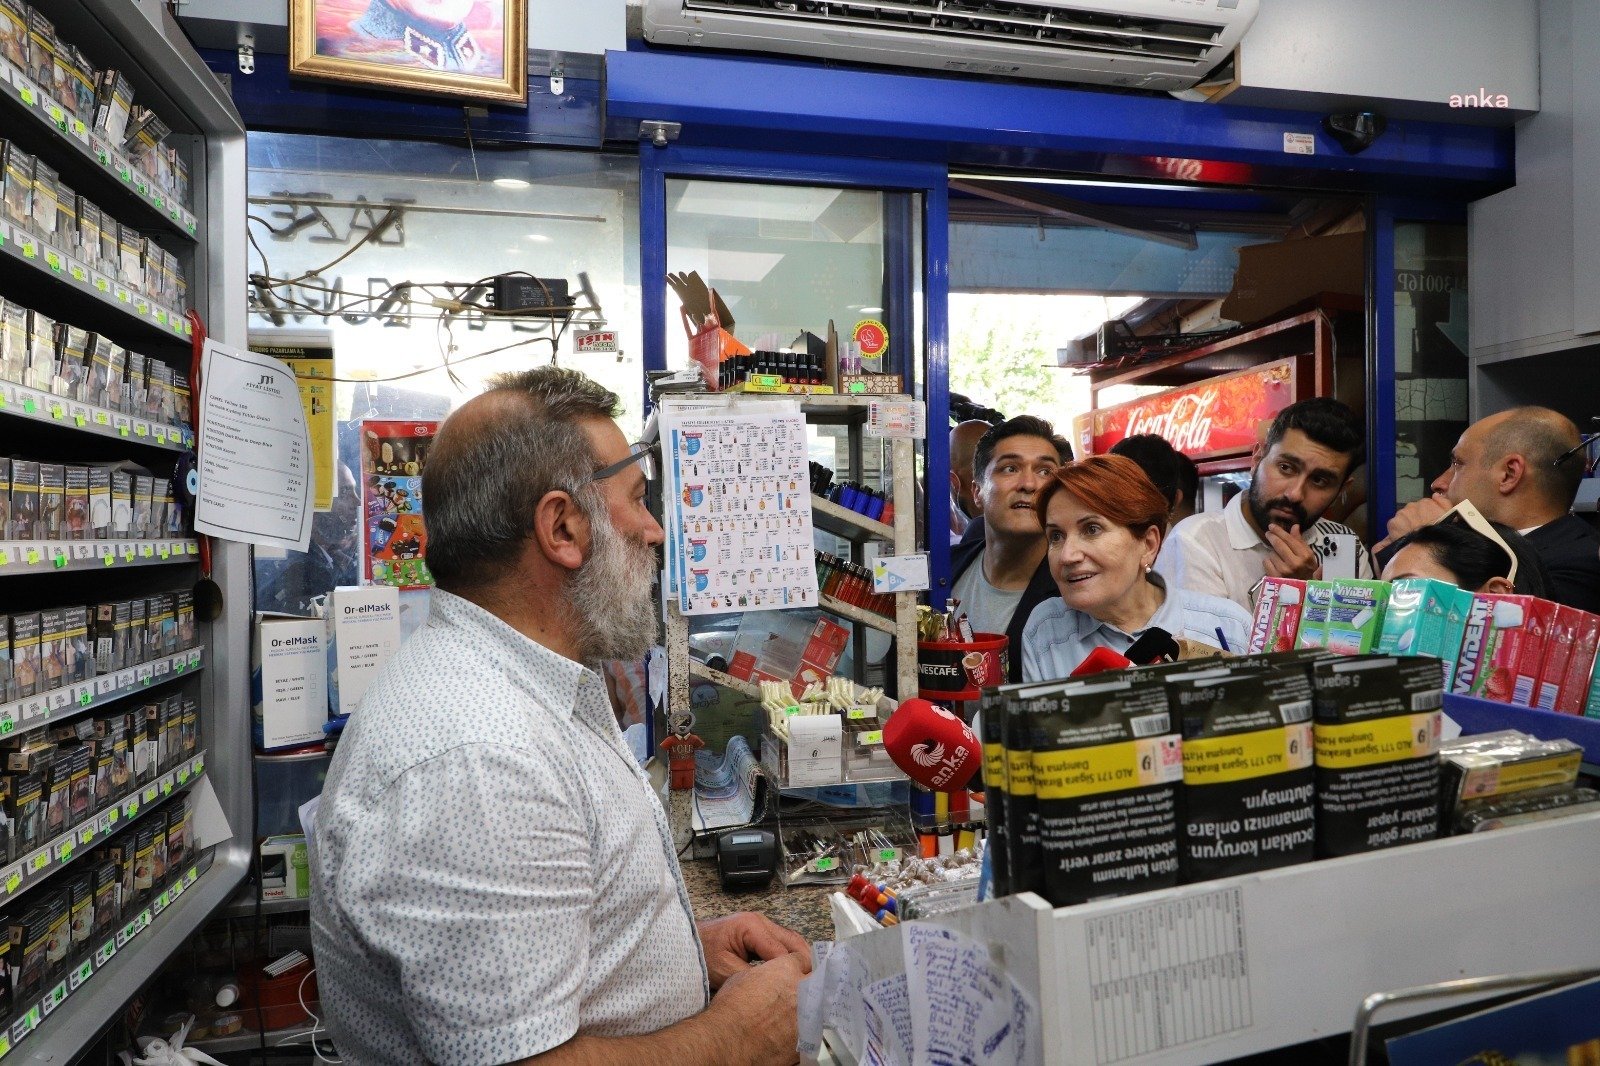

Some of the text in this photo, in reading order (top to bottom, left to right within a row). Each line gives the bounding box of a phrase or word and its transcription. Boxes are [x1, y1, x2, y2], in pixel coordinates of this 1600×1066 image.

[344, 603, 391, 614] Or-elMask
[271, 636, 318, 647] Or-elMask
[1353, 675, 1360, 687] 5
[1062, 699, 1070, 712] 5
[1206, 747, 1243, 758] Danışma
[1354, 746, 1379, 755] Sigara
[1381, 744, 1395, 752] 171
[931, 746, 965, 785] anka
[1047, 761, 1089, 773] Danışma
[1222, 759, 1248, 770] Sigara
[1250, 757, 1264, 766] 171
[1066, 773, 1095, 785] Sigara
[1097, 771, 1112, 781] 171
[1367, 810, 1399, 828] yapar
[1186, 820, 1240, 839] onlara
[1366, 826, 1398, 846] görür
[1091, 849, 1122, 865] zarar
[1059, 855, 1090, 872] verir
